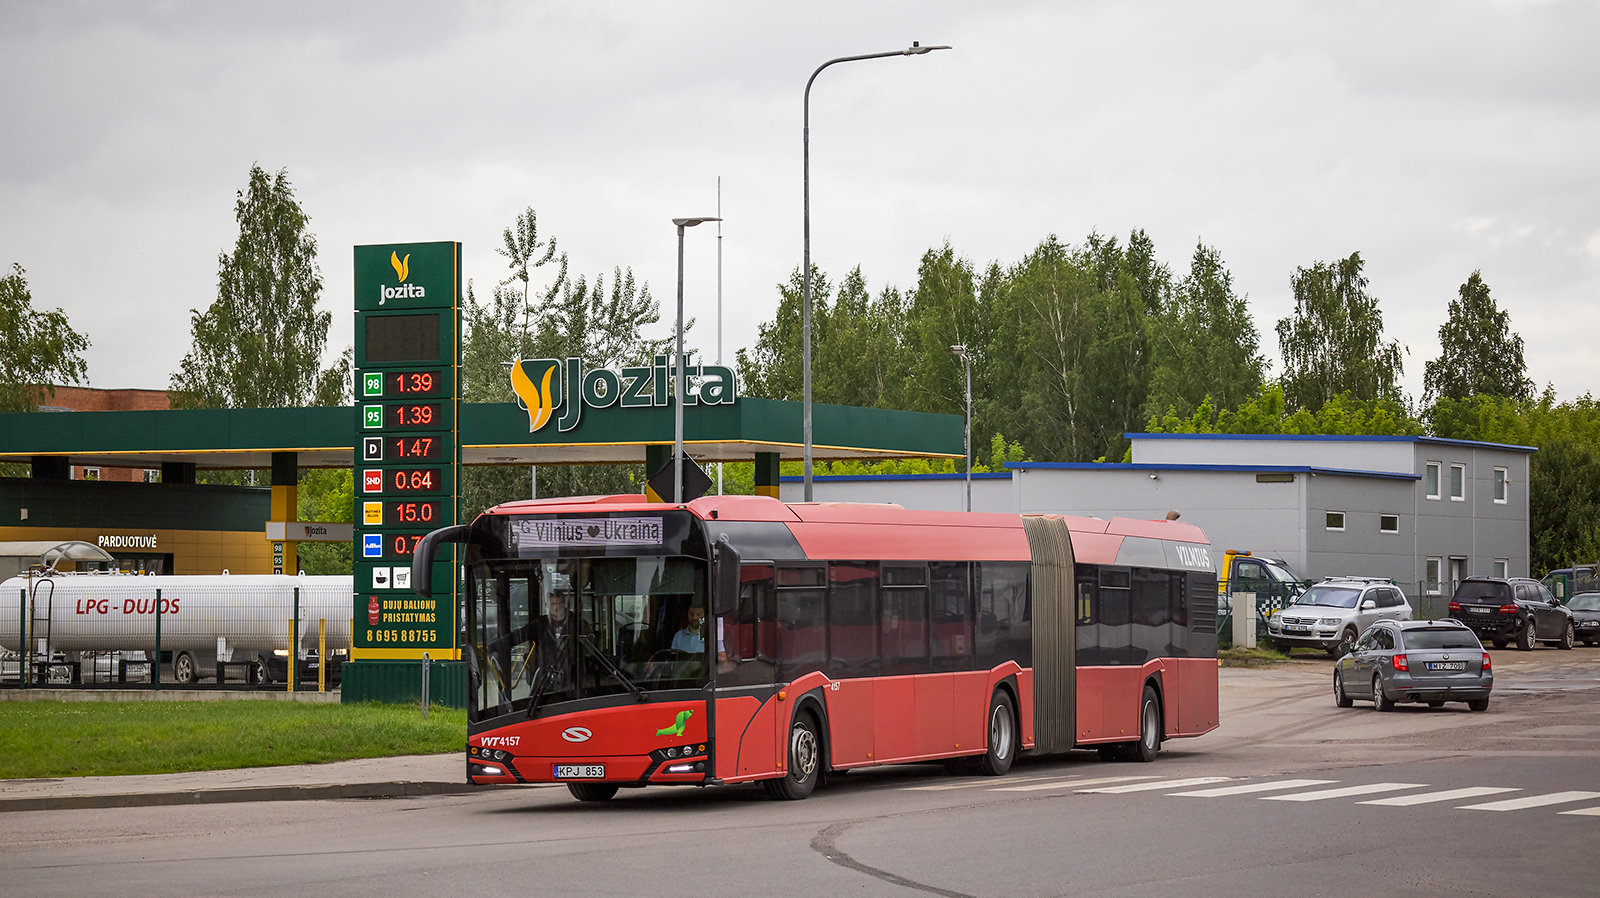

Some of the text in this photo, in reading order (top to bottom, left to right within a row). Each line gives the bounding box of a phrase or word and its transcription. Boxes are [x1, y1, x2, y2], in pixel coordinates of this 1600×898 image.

[379, 283, 425, 305] Jozita
[367, 373, 433, 392] 98 1.39
[558, 354, 736, 432] Jozita
[367, 405, 433, 425] 95 1.39
[369, 438, 433, 457] D 1.47
[366, 470, 433, 490] SND 0.64
[396, 503, 433, 522] 15.0
[98, 534, 157, 548] PARDUOTUVĖ
[535, 522, 583, 542] Vilnius
[604, 520, 660, 544] Ukrainą
[394, 535, 425, 555] 0.7
[1175, 545, 1211, 568] VILNIUS
[76, 599, 109, 614] LPG
[123, 598, 180, 615] DUJOS
[383, 600, 402, 612] DUJŲ
[403, 600, 436, 612] BALIONŲ
[383, 613, 436, 623] PRISTATYMAS
[366, 629, 437, 642] 8 695 88755
[559, 766, 603, 776] KPJ 853
